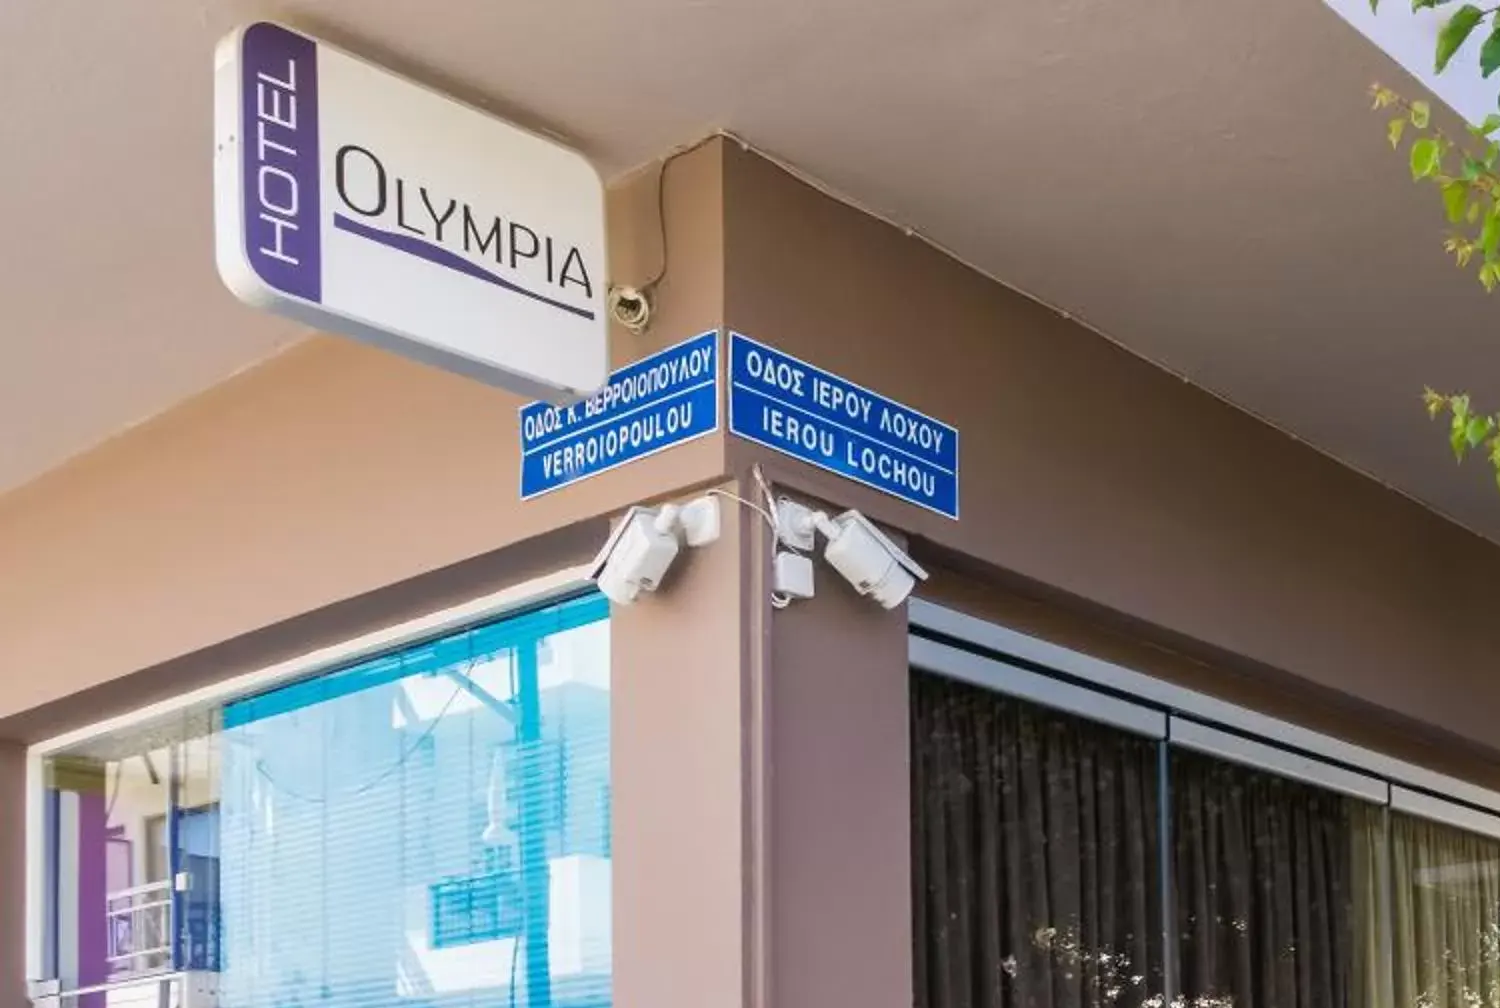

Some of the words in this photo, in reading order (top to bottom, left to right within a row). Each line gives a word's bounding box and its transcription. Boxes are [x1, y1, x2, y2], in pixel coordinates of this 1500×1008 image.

[257, 60, 298, 265] HOTEL
[336, 145, 593, 298] OLYMPIA
[525, 407, 563, 441] ΟΔΟΣ
[543, 401, 693, 478] VERROIOPOULOU
[746, 351, 805, 397] ΟΔΟΣ
[813, 377, 871, 422] ΙΕΡΟΥ
[880, 409, 944, 455] ΛΟΧΟΥ
[762, 407, 835, 457] IEROU
[847, 441, 936, 498] LOCHOU
